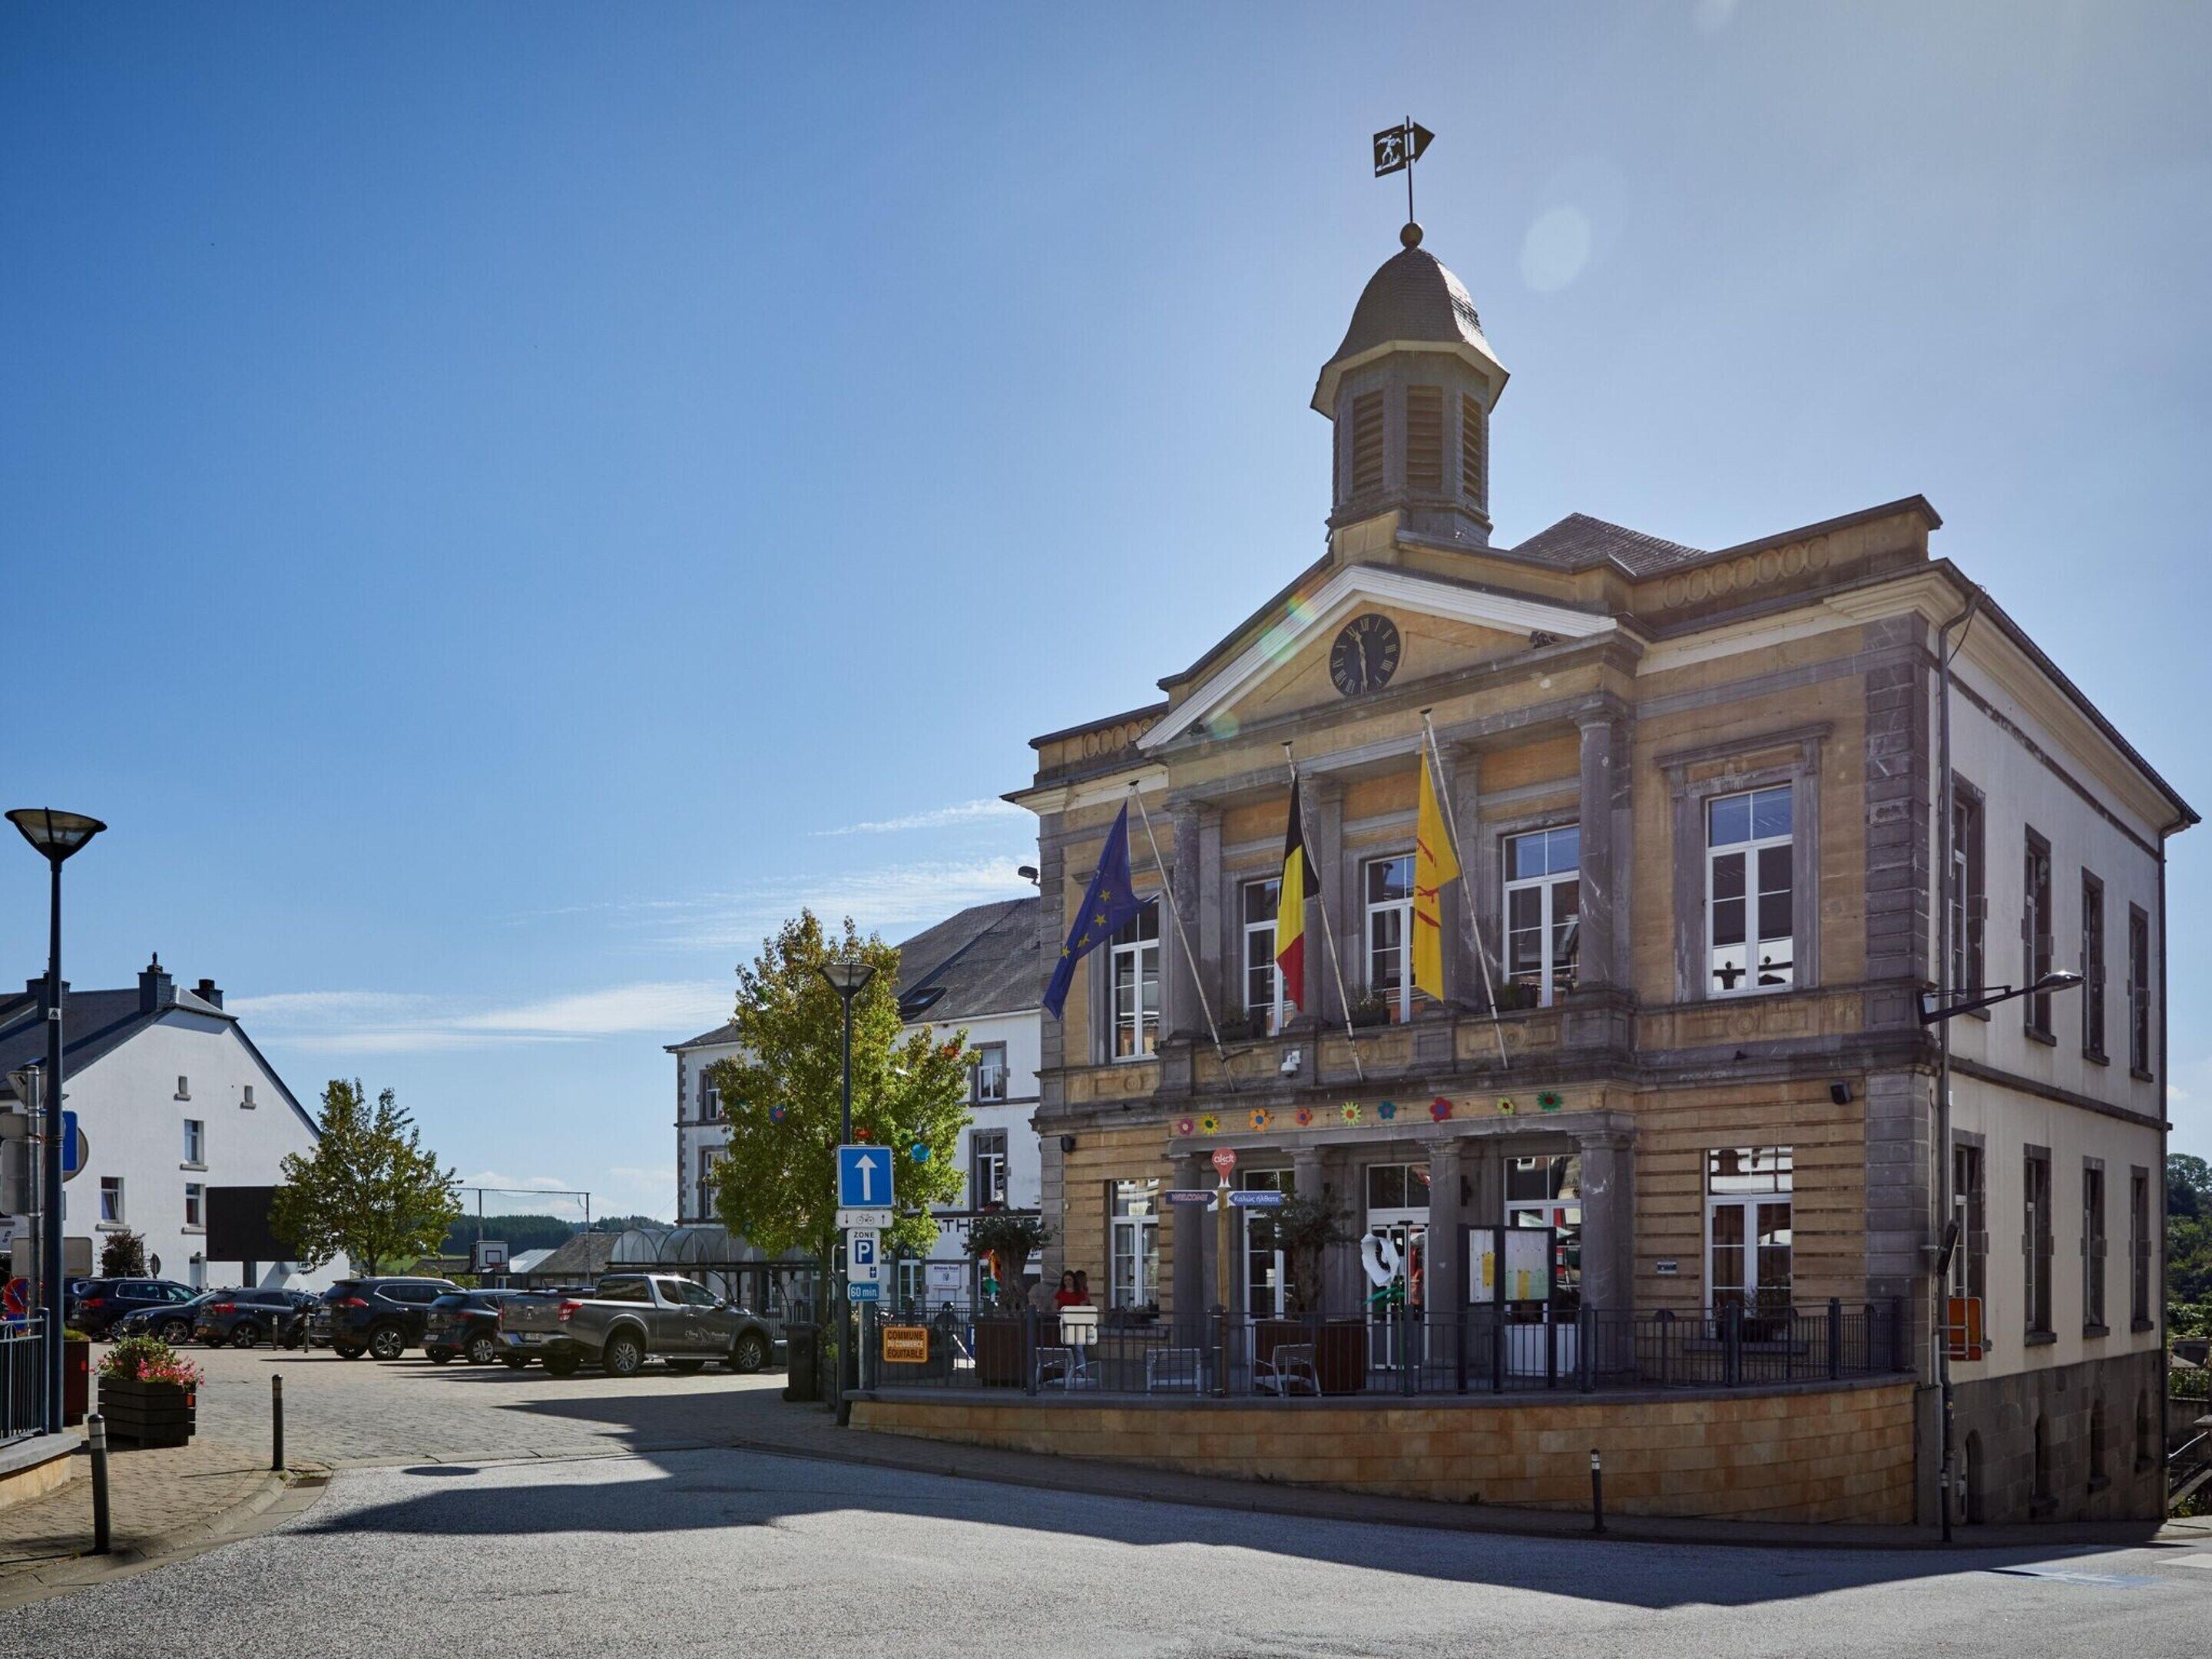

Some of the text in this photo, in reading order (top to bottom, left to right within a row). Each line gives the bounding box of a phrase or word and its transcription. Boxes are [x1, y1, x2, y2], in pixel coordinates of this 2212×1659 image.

[858, 1241, 870, 1263] P
[850, 1287, 861, 1297] 60
[887, 1330, 925, 1341] COMMUNE
